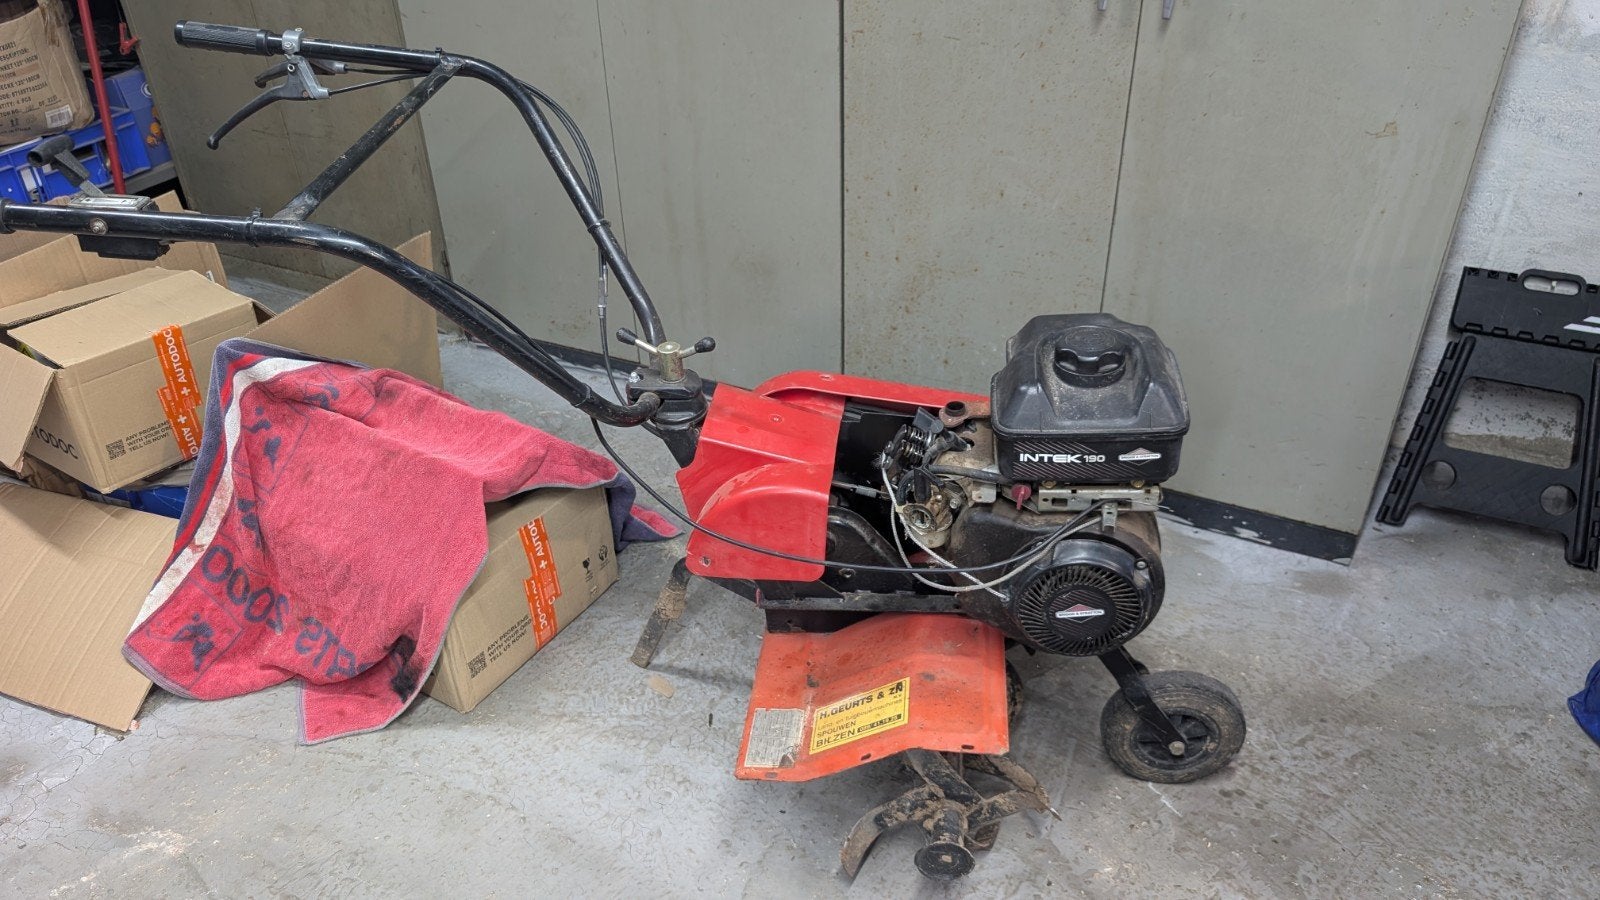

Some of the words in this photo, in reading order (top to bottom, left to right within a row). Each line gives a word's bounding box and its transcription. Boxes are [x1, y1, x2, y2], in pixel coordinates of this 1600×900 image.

[0, 47, 30, 62] ESCRIPTION:
[0, 62, 13, 72] NKET
[163, 329, 188, 383] AUTODOC
[126, 432, 138, 442] ANY
[127, 437, 144, 447] WITH
[181, 427, 199, 457] AUTO
[129, 443, 144, 453] TELL
[1019, 453, 1082, 464] INTEK
[1083, 454, 1106, 463] 190
[487, 639, 499, 652] ANY
[488, 643, 504, 657] WITH
[490, 651, 503, 663] TELL
[503, 644, 512, 652] US
[876, 691, 885, 700] &
[817, 720, 857, 738] SPOUWEN
[816, 729, 855, 748] BILZEN
